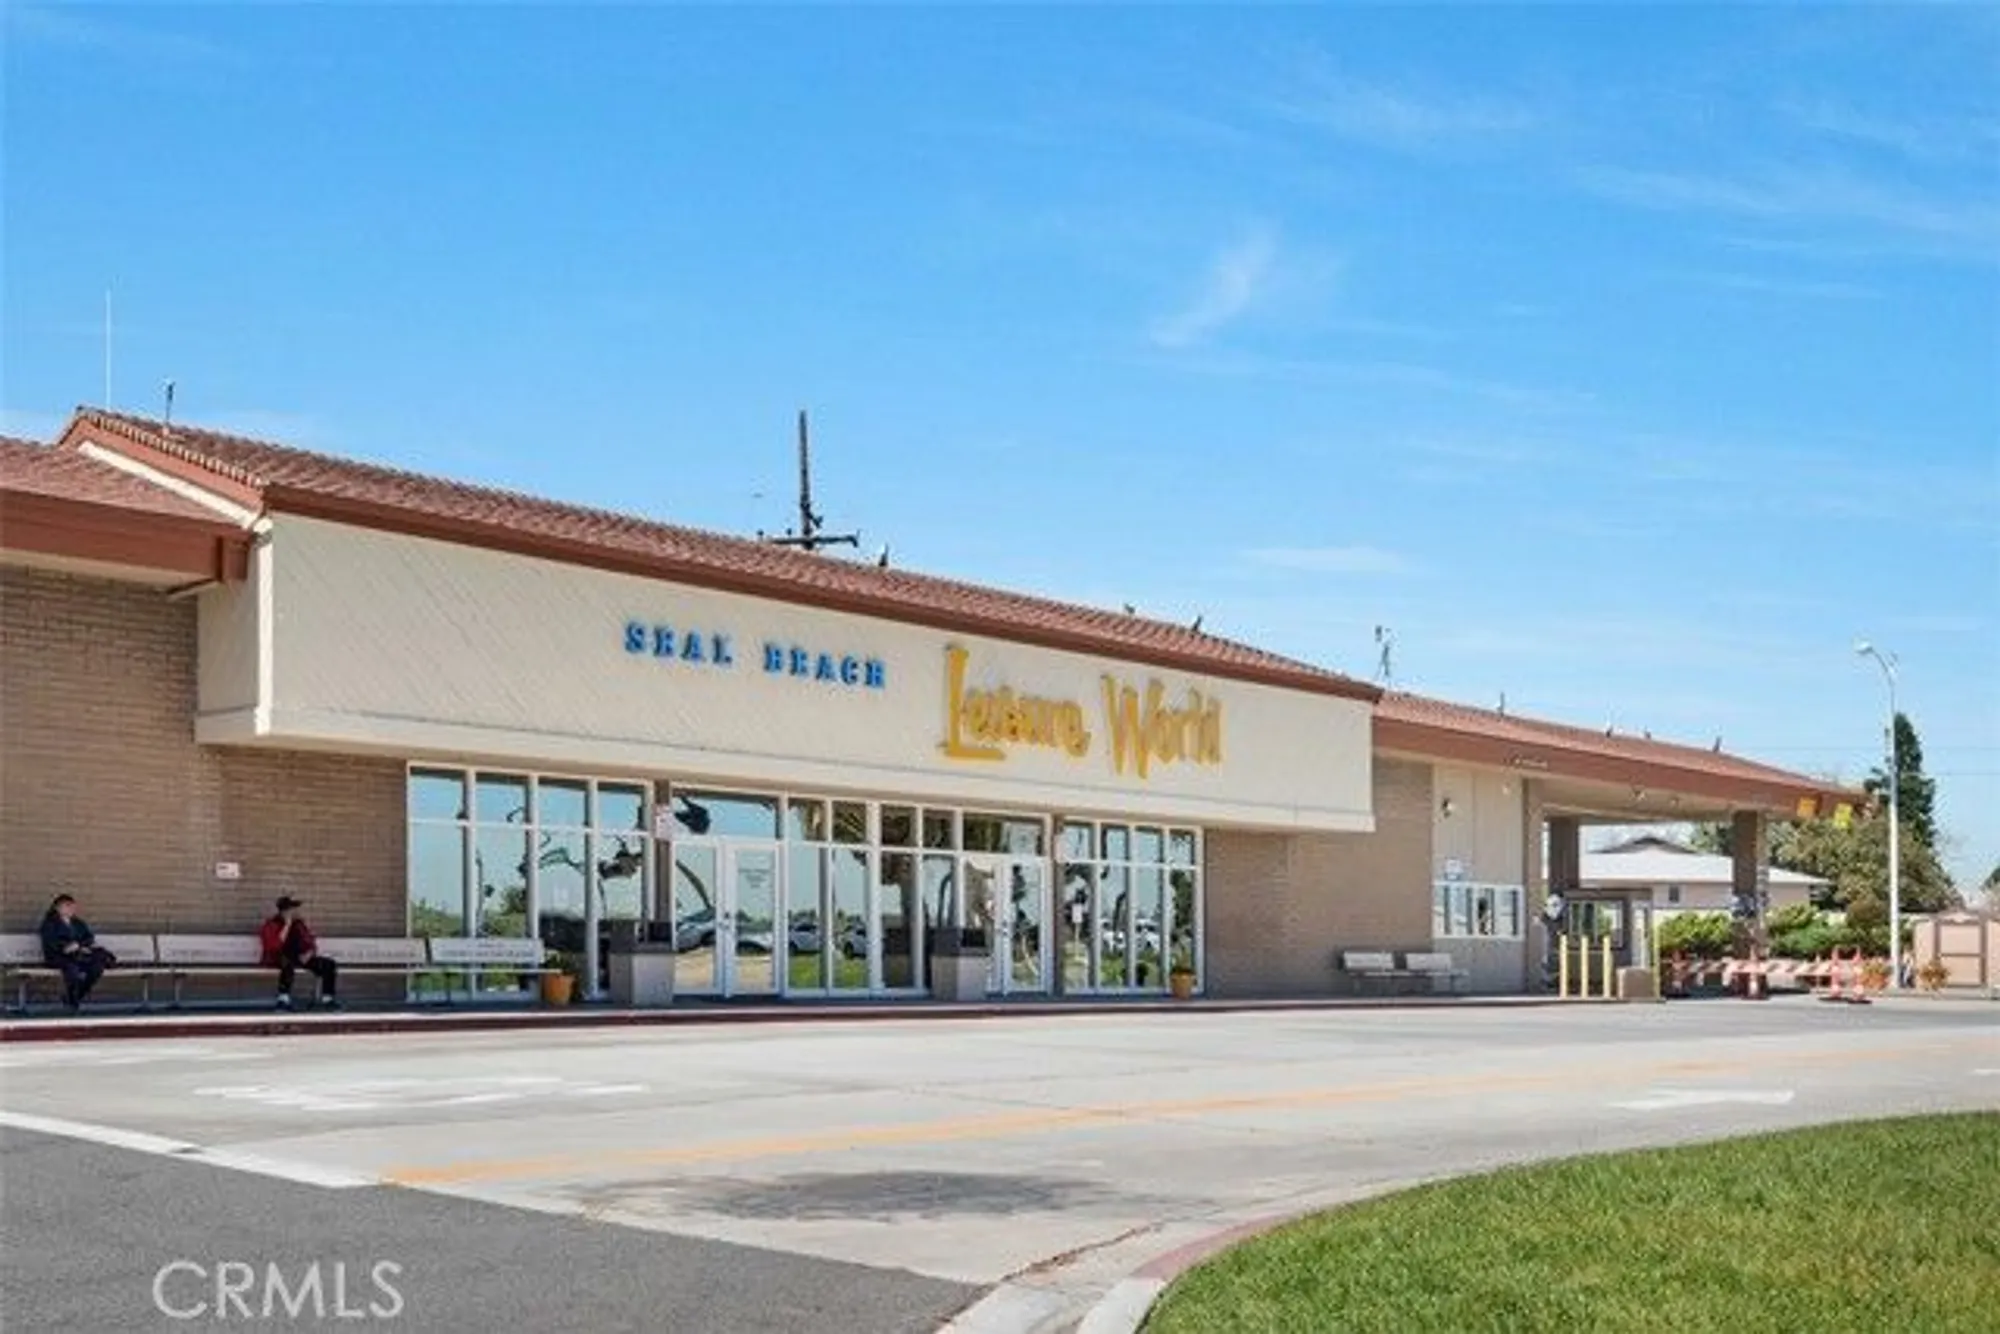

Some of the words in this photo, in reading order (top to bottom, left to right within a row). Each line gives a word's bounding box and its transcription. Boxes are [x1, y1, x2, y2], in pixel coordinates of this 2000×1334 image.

[624, 621, 732, 665] SEAL
[763, 642, 886, 688] BEACH
[937, 642, 1091, 760] Leisure
[1101, 673, 1221, 779] World
